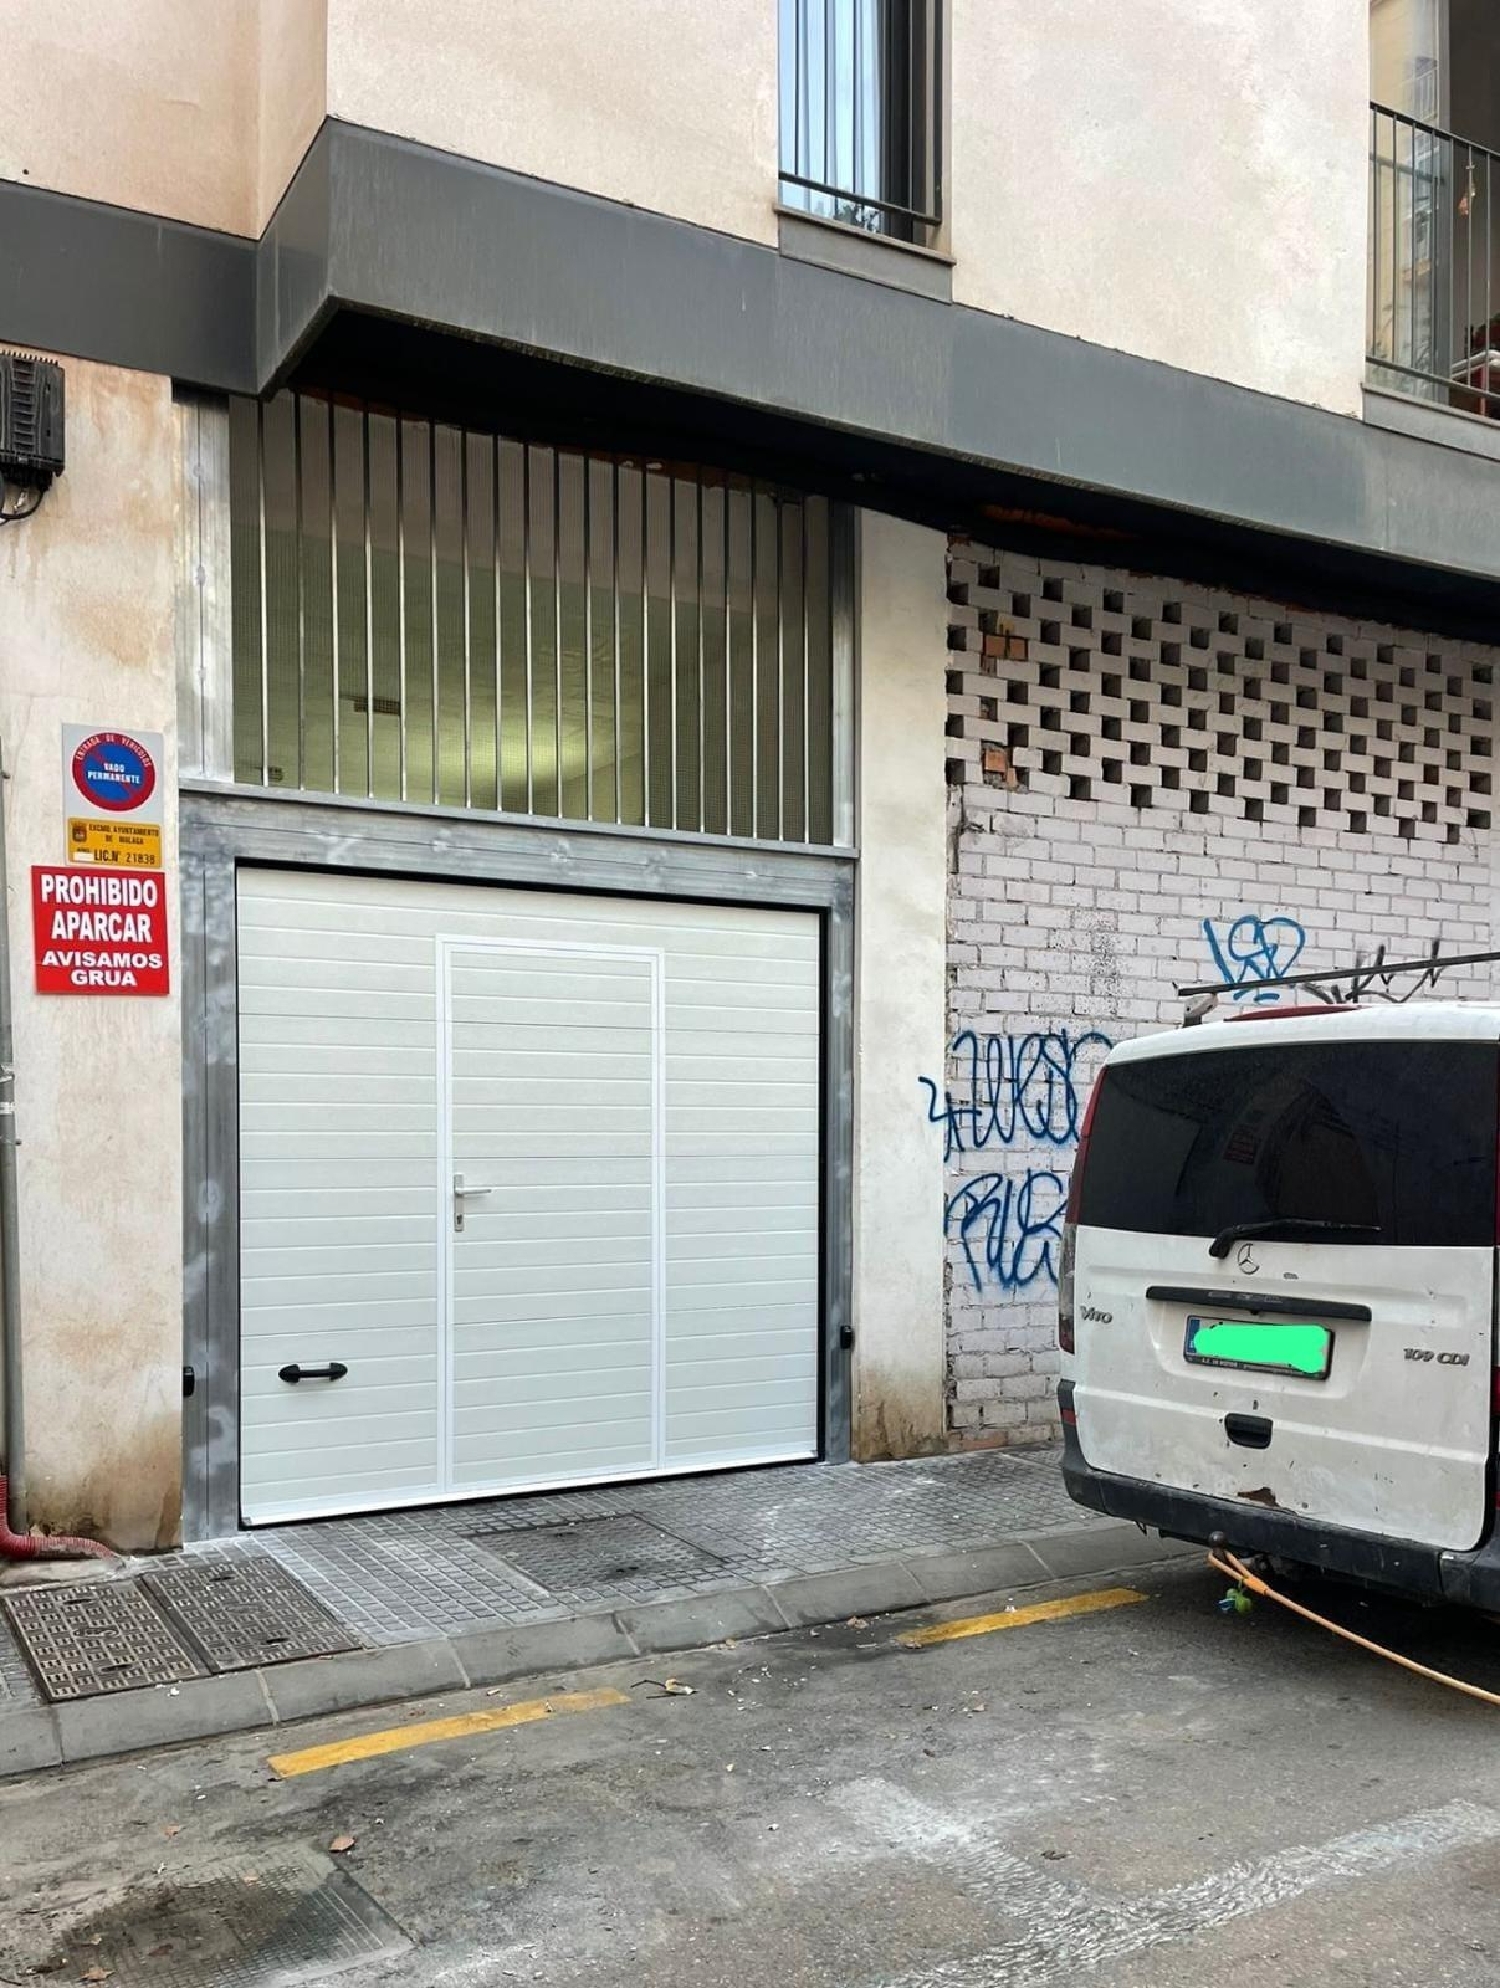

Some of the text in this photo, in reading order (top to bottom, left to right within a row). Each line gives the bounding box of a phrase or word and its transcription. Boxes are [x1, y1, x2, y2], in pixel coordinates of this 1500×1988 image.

[87, 771, 140, 784] PERMANENTE
[41, 874, 158, 908] PROHIBIDO
[51, 910, 153, 943] APARCAR
[42, 951, 163, 969] AVISAMOS
[71, 969, 137, 987] GRUA
[1437, 1352, 1471, 1367] CDI
